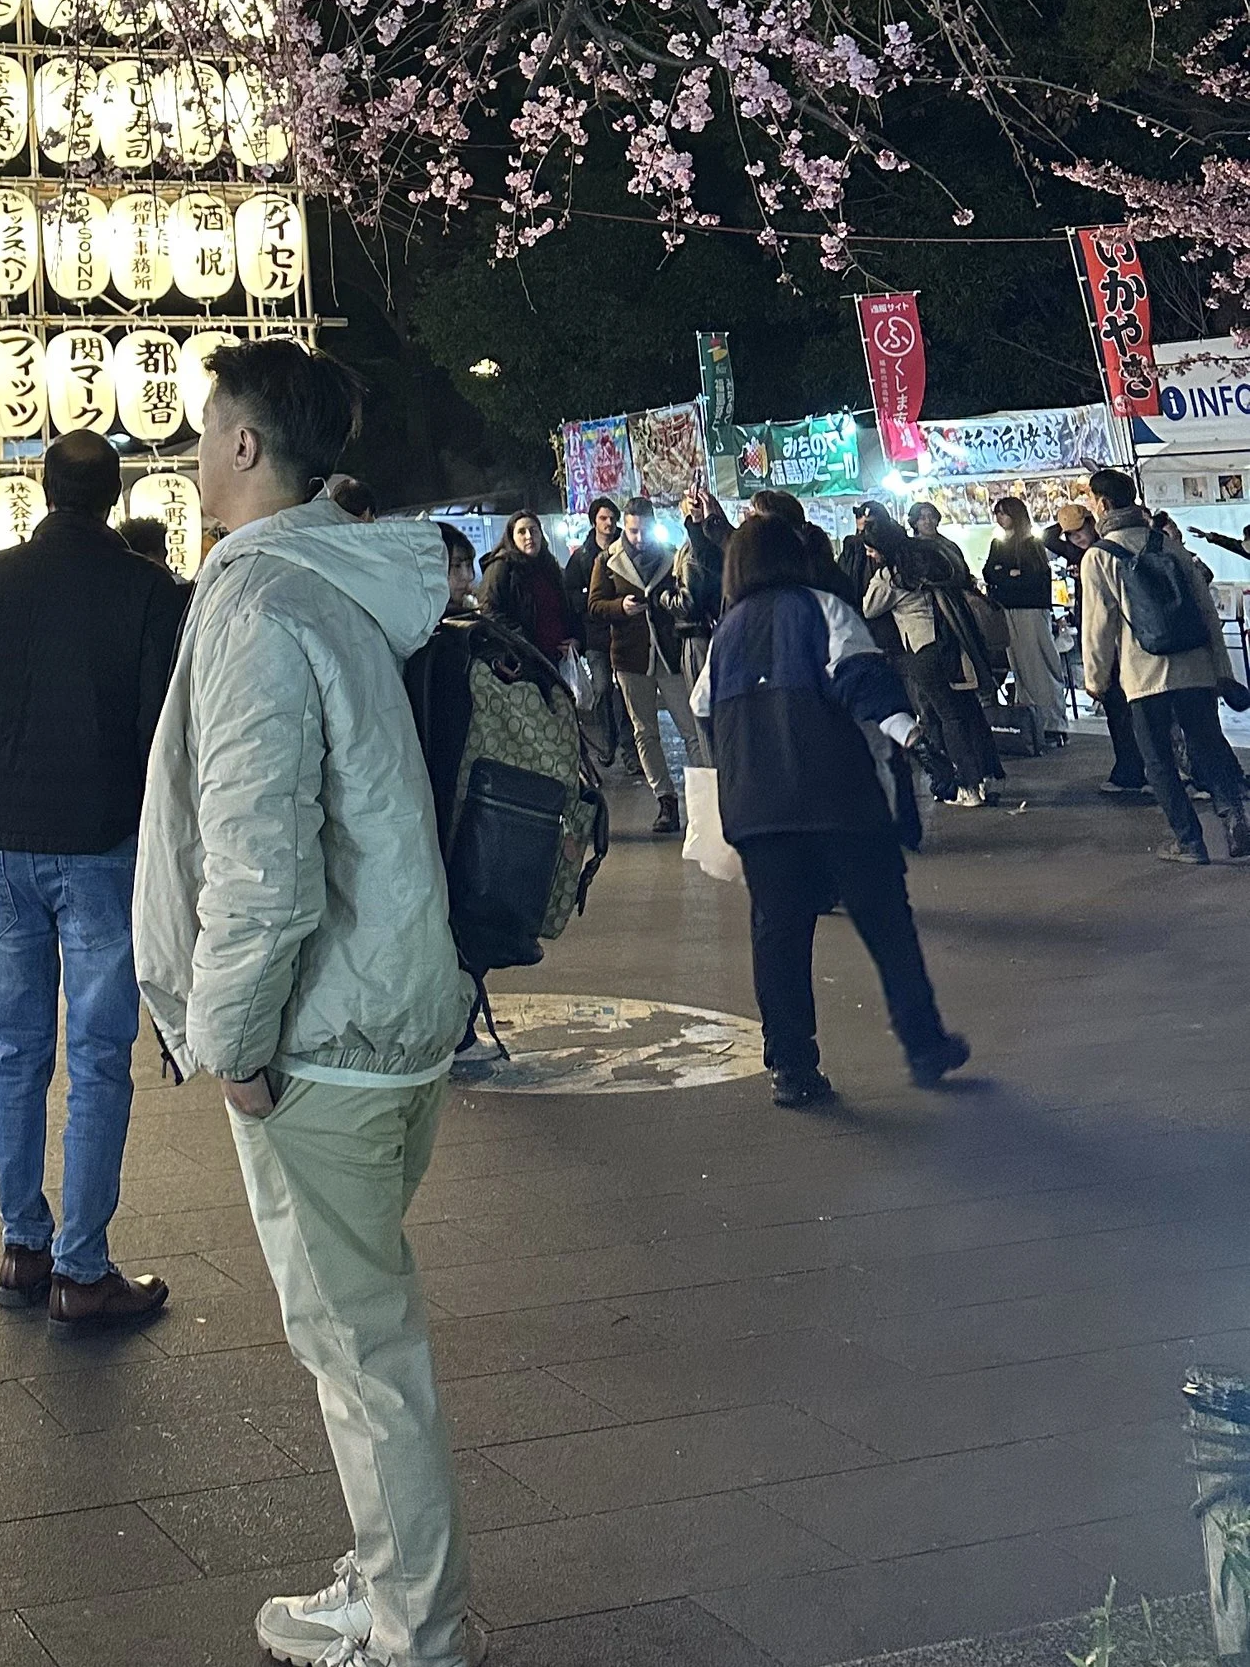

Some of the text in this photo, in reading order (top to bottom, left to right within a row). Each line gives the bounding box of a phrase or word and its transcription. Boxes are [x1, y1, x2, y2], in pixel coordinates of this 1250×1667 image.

[77, 197, 93, 291] JOYSOUND
[131, 200, 152, 291] 税理士事務所
[195, 203, 226, 276] 酒悦
[136, 339, 178, 425] 都響
[769, 449, 859, 486] 福島路ビール
